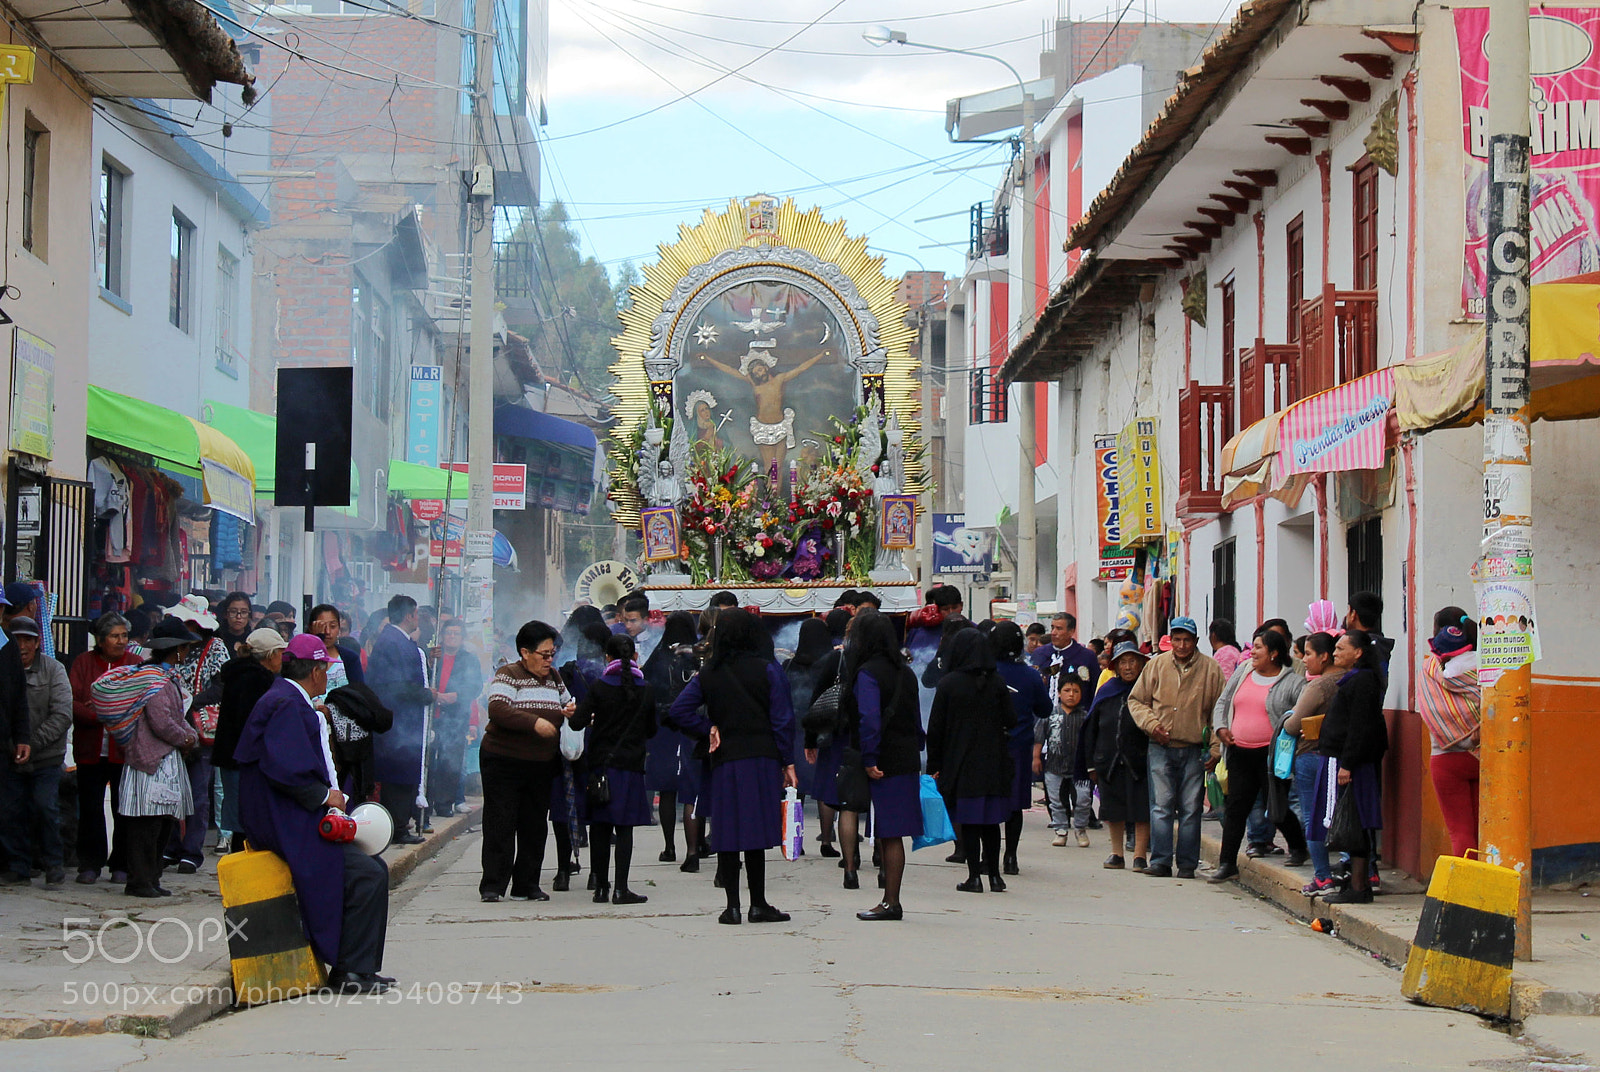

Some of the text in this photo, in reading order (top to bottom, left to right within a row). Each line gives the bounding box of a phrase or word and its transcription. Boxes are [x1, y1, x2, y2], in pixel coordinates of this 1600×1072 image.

[1469, 99, 1600, 158] BAHM
[1492, 142, 1528, 413] LICORE
[1299, 398, 1389, 464] Prendas de vestir
[493, 498, 521, 507] ENTE
